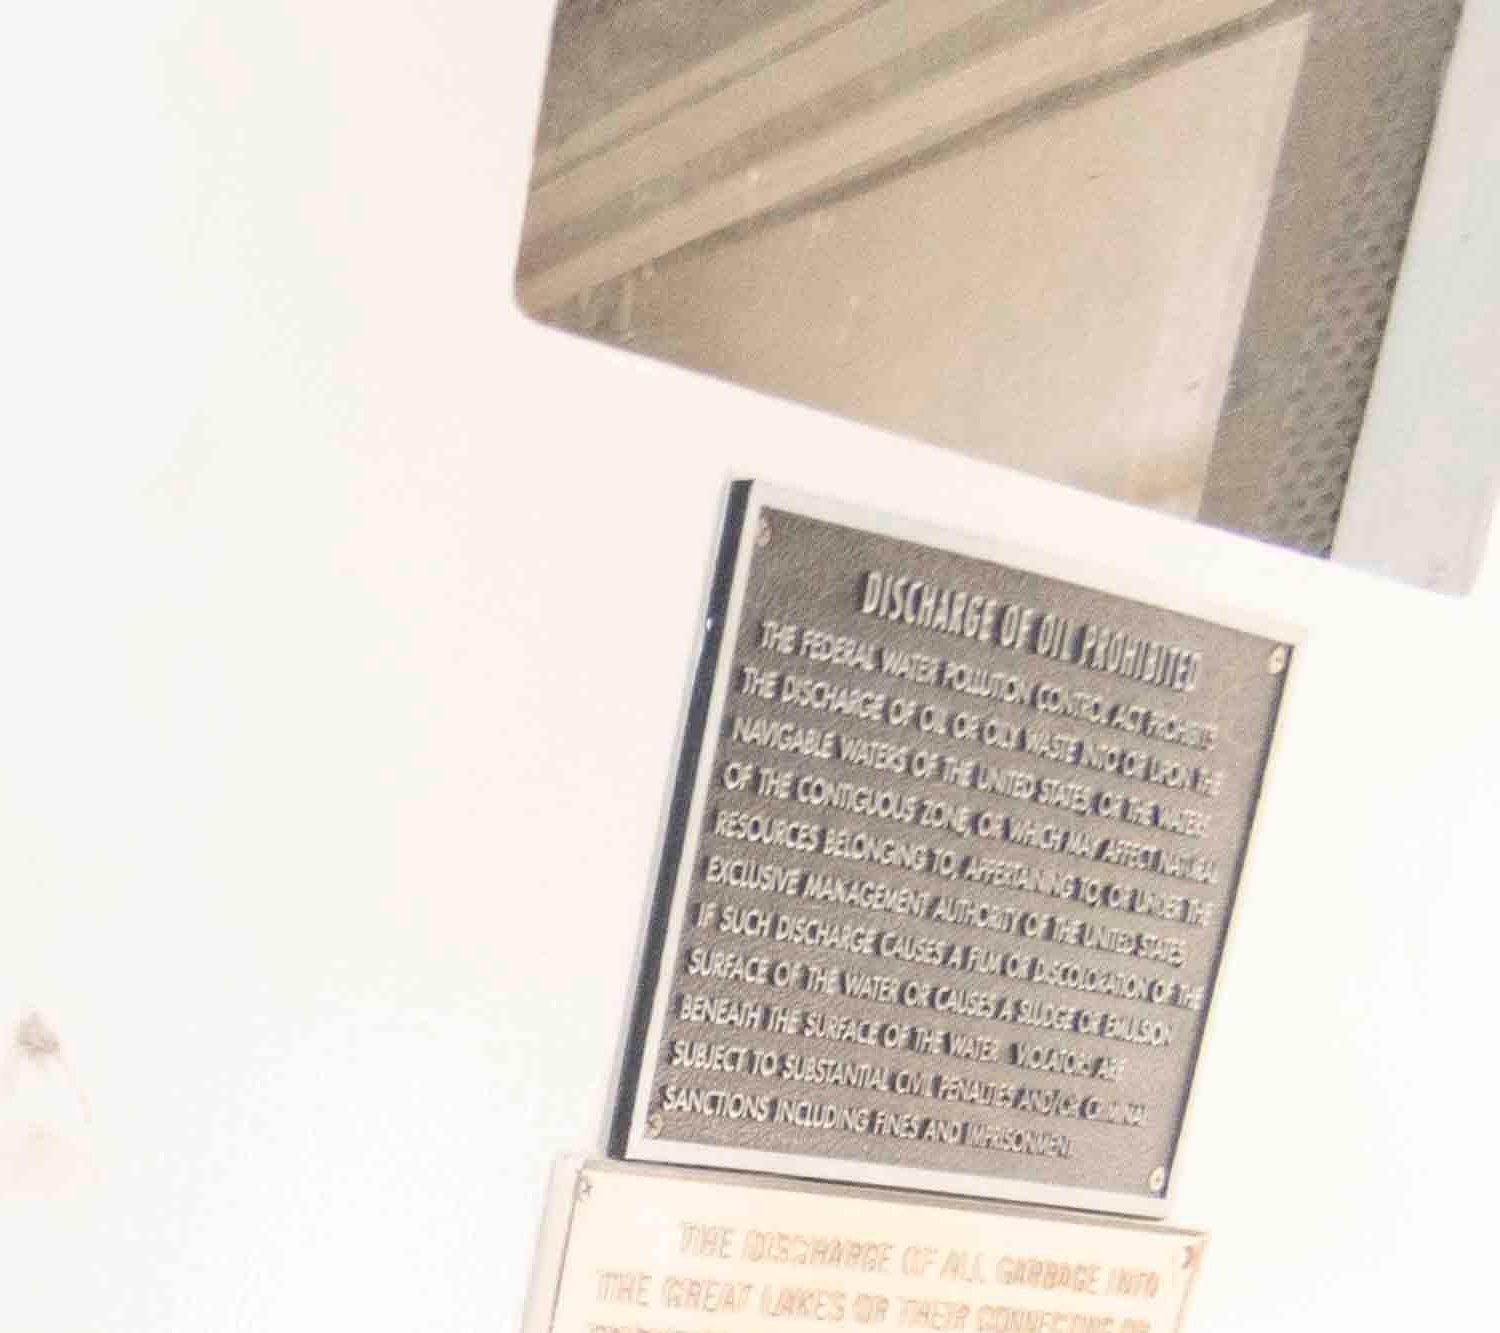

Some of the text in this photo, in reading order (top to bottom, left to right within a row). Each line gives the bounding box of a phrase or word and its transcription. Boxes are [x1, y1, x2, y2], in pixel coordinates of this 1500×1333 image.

[761, 619, 797, 653] THE
[801, 629, 877, 672] FEDERAL
[881, 648, 940, 686] WATER
[863, 570, 1202, 692] DISCHARGE OF OIL PROHIBITED
[741, 666, 777, 698] THE
[782, 675, 884, 721] DISCHARGE
[890, 700, 916, 728] OF
[920, 706, 948, 735] OIL
[1025, 730, 1079, 764] WASTE
[733, 713, 834, 759] NAVIGABLE
[839, 736, 907, 774] WATERS
[912, 751, 938, 780] OF
[943, 758, 975, 788] THE
[977, 765, 1036, 800] UNITED
[724, 761, 752, 792] OF
[757, 768, 792, 800] THE
[797, 775, 917, 824] CONTIGUOUS
[1009, 818, 1061, 852] WHICH
[715, 809, 818, 852] RESOURCES
[823, 829, 926, 872] BELONGING
[697, 903, 714, 930] IF
[720, 906, 770, 939] SUCH
[776, 916, 877, 955] DISCHARGE
[880, 933, 944, 966] CAUSES
[948, 944, 964, 969] A
[707, 856, 1135, 952] EXCLUSIVE MANAGEMENT AUTHORITY OF THE UNITED
[689, 950, 769, 985] SURFACE
[773, 963, 800, 990] OF
[806, 968, 839, 996] THE
[844, 973, 900, 1004] WATER
[904, 983, 930, 1009] OR
[935, 987, 996, 1018] CAUSES
[1000, 997, 1014, 1021] A
[1019, 1000, 1076, 1030] SLUDGE
[680, 995, 761, 1029] BENEATH
[768, 1007, 802, 1035] THE
[804, 1013, 879, 1045] SURFACE
[884, 1024, 909, 1049] OF
[915, 1028, 944, 1054] THE
[672, 1041, 745, 1073] SUBJECT
[752, 1051, 778, 1077] TO
[783, 1055, 891, 1091] SUBSTANTIAL
[895, 1070, 935, 1096] CIVIL
[940, 1076, 1015, 1106] PENALTIES
[663, 1086, 960, 1143] SANCTIONS INCLUDING FINES AND
[676, 1221, 735, 1260] THE
[592, 1270, 652, 1308] THE
[661, 1276, 752, 1315] GREAT
